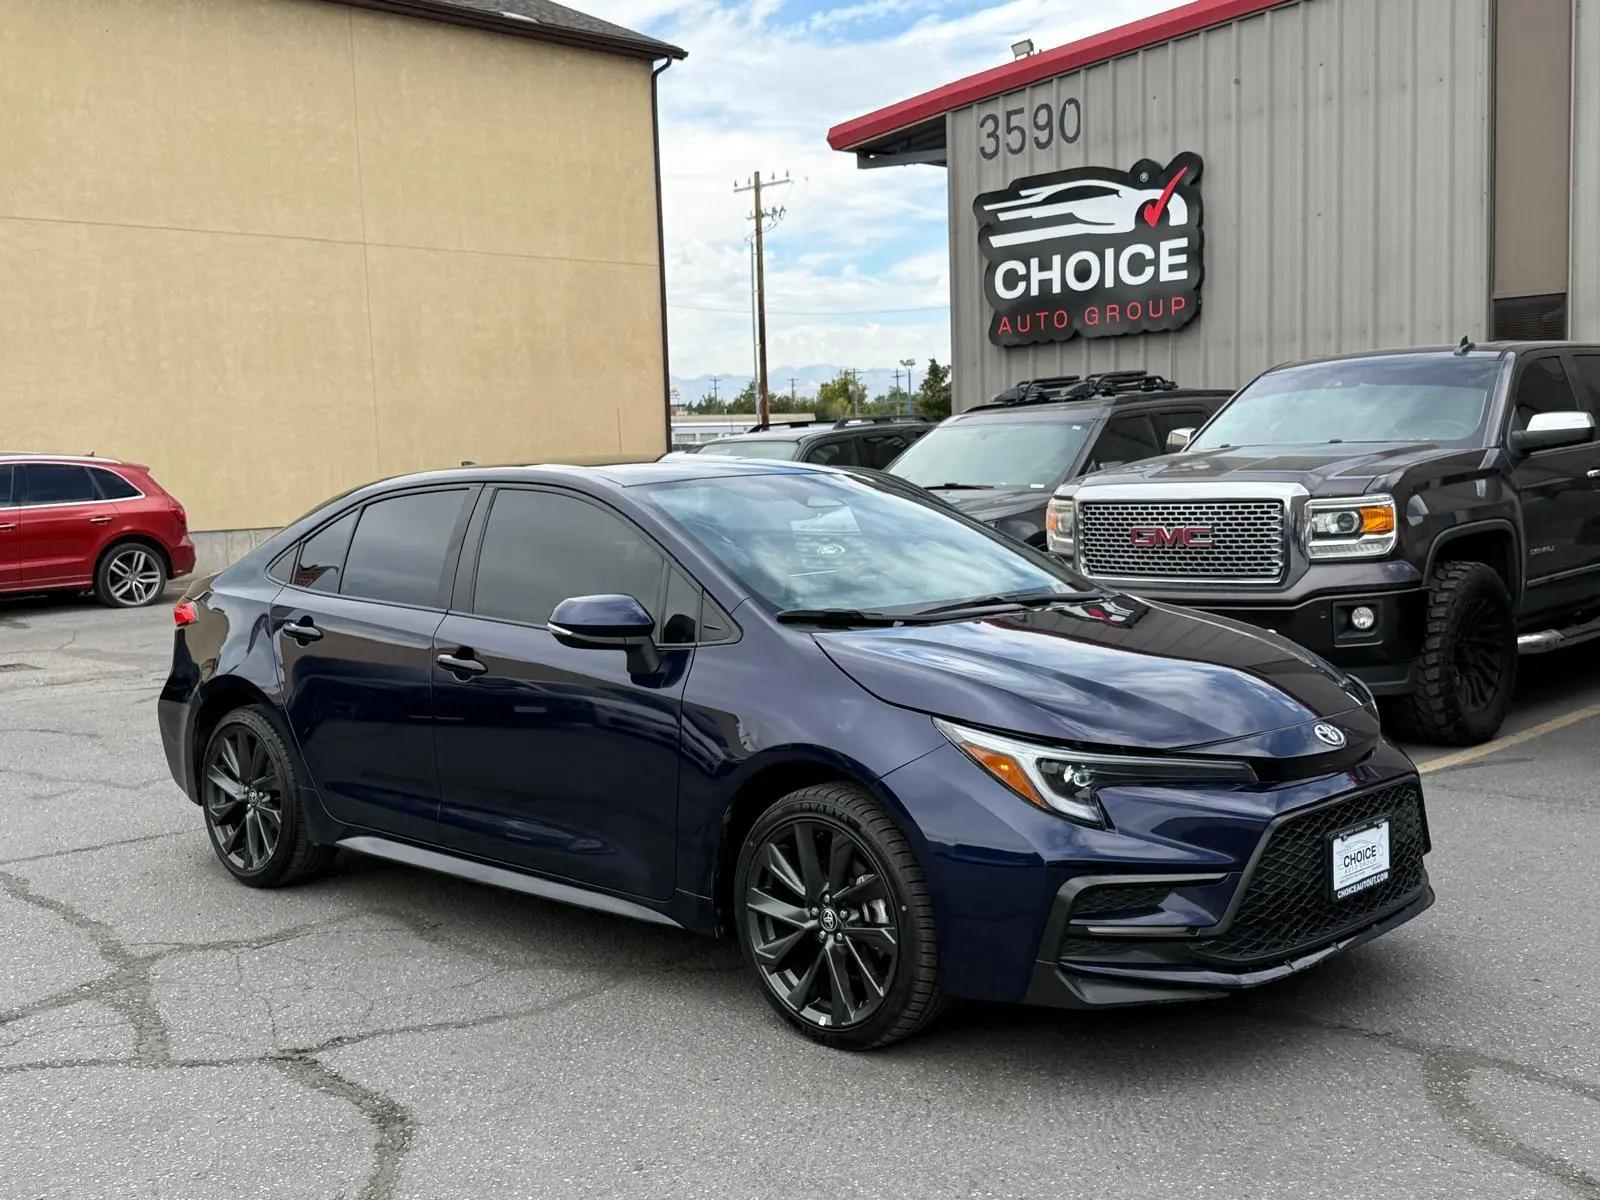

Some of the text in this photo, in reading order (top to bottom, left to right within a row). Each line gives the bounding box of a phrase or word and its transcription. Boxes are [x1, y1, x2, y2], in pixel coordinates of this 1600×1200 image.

[979, 97, 1081, 160] 3590
[994, 237, 1188, 300] CHOICE
[998, 296, 1186, 334] AUTO GROUP
[1130, 525, 1214, 550] GMC
[1343, 845, 1377, 868] CHOICE
